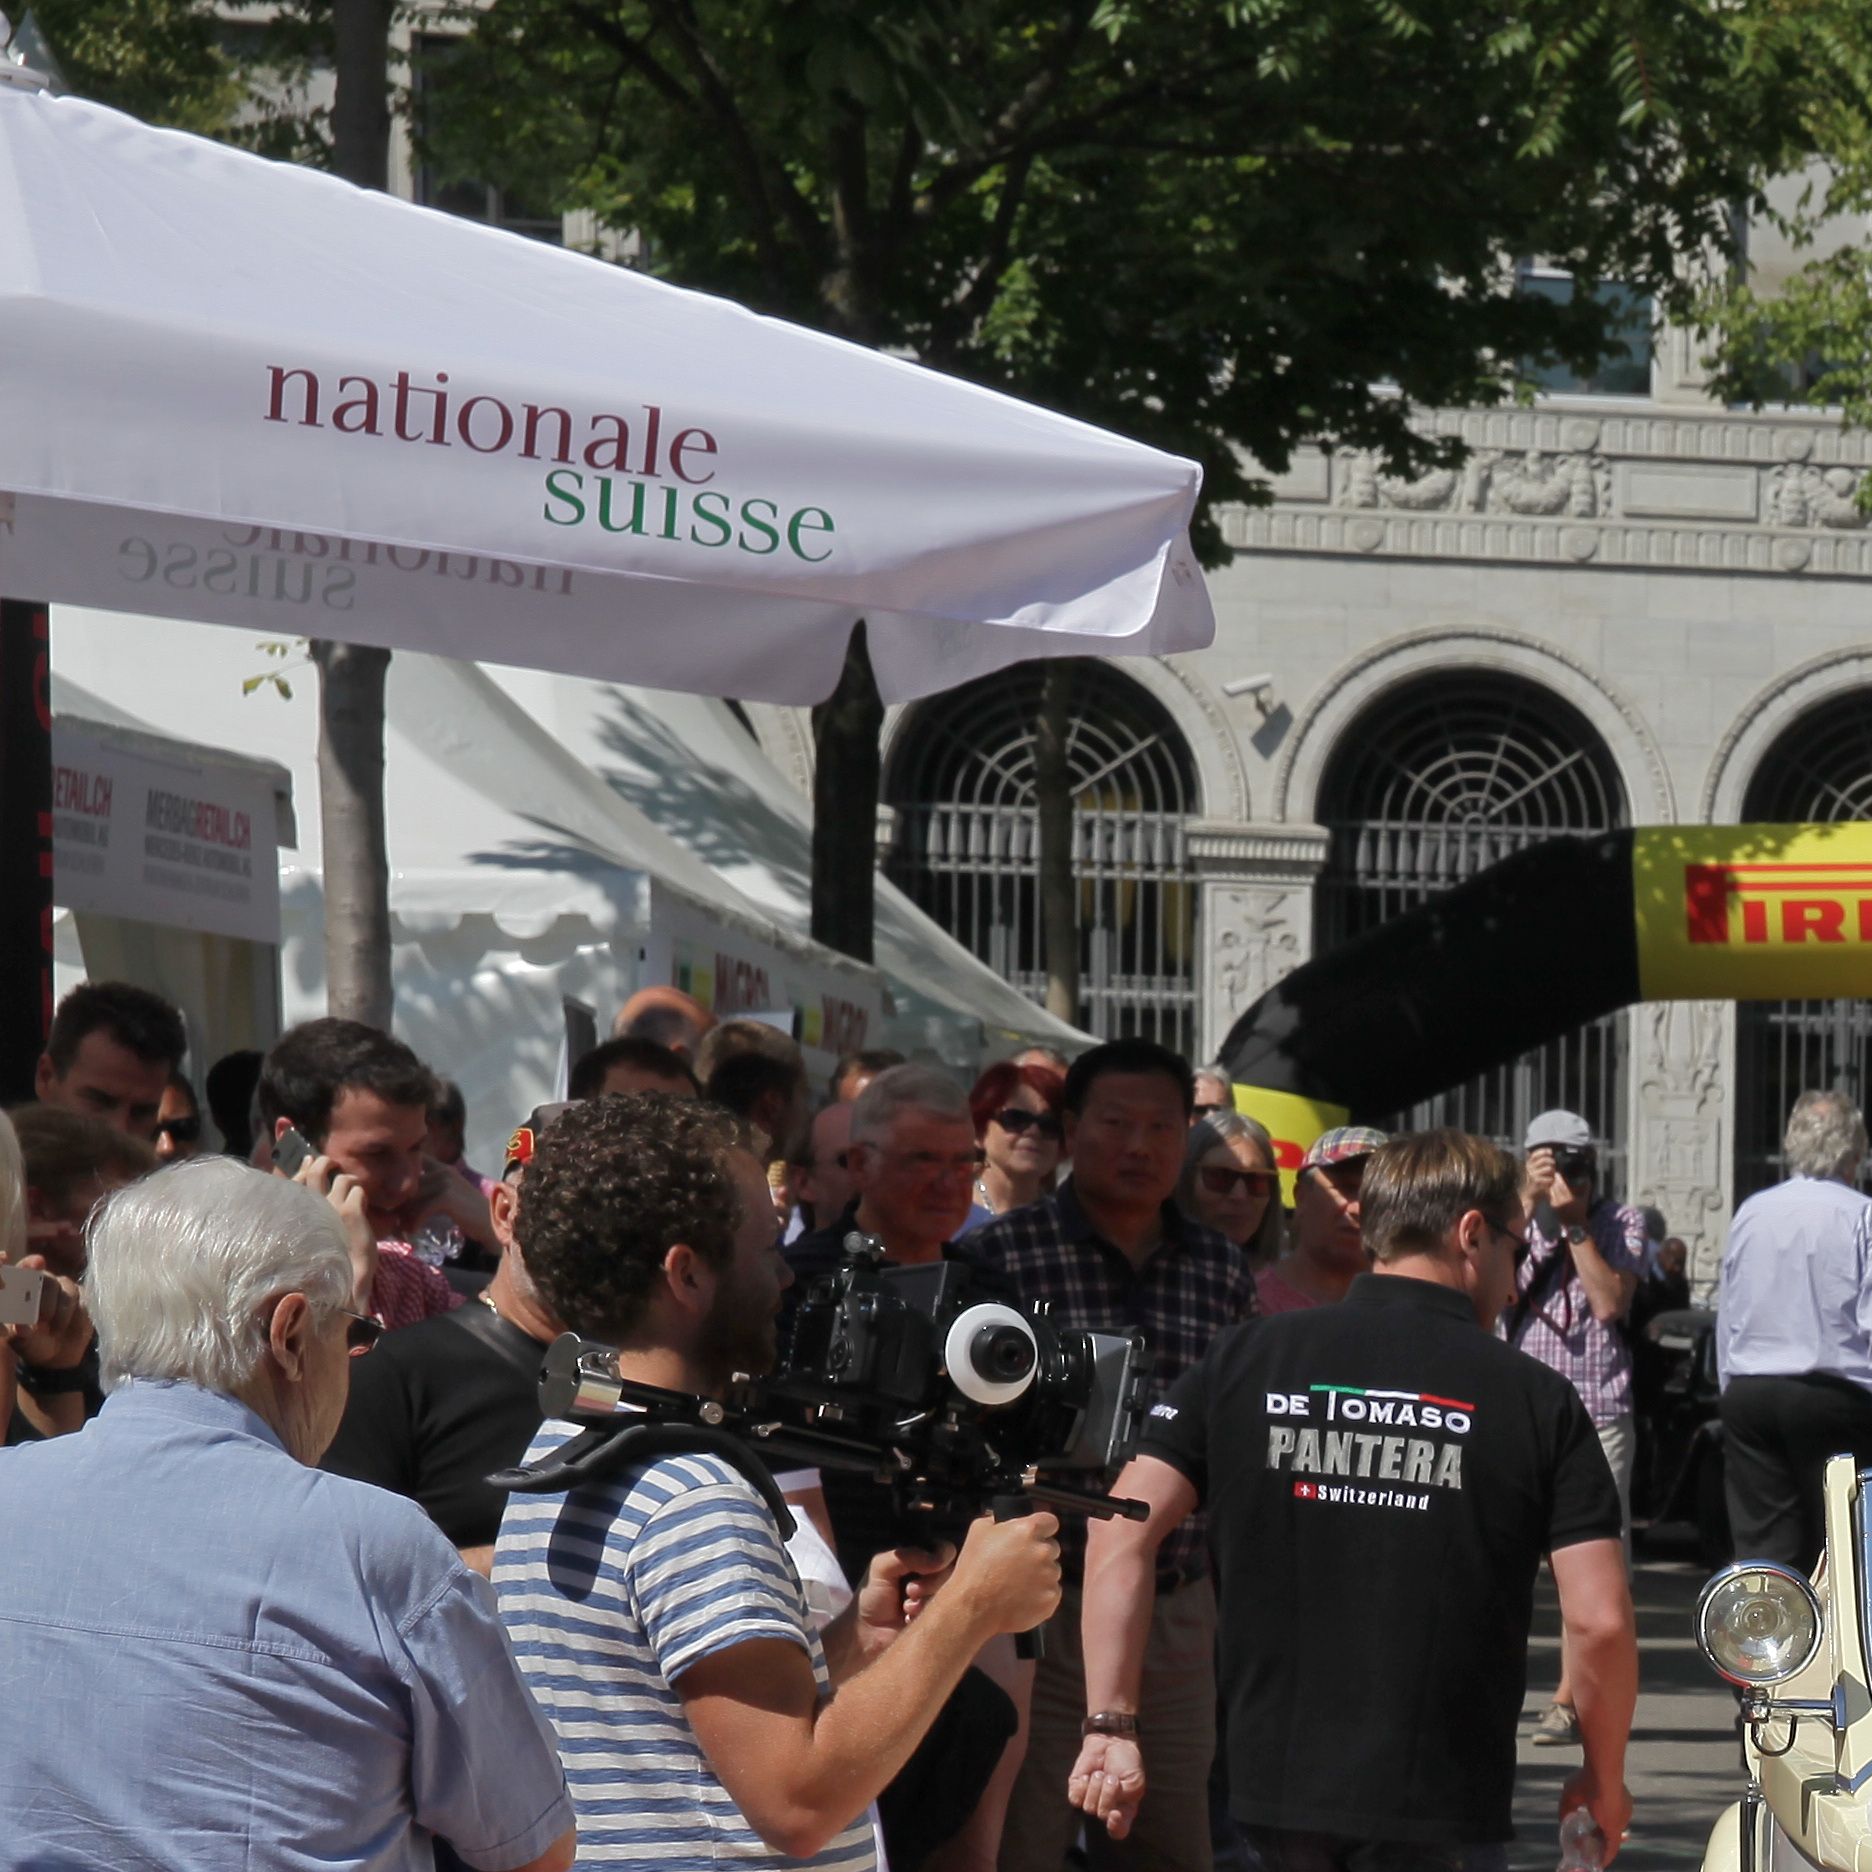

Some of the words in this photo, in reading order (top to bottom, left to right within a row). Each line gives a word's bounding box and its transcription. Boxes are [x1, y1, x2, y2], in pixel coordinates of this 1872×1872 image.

[263, 364, 718, 485] nationale
[543, 467, 836, 563] suisse
[1265, 1392, 1310, 1416] DE
[1311, 1385, 1475, 1435] TOMASO
[1266, 1425, 1463, 1490] PANTERA
[1317, 1484, 1431, 1511] Switzerland
